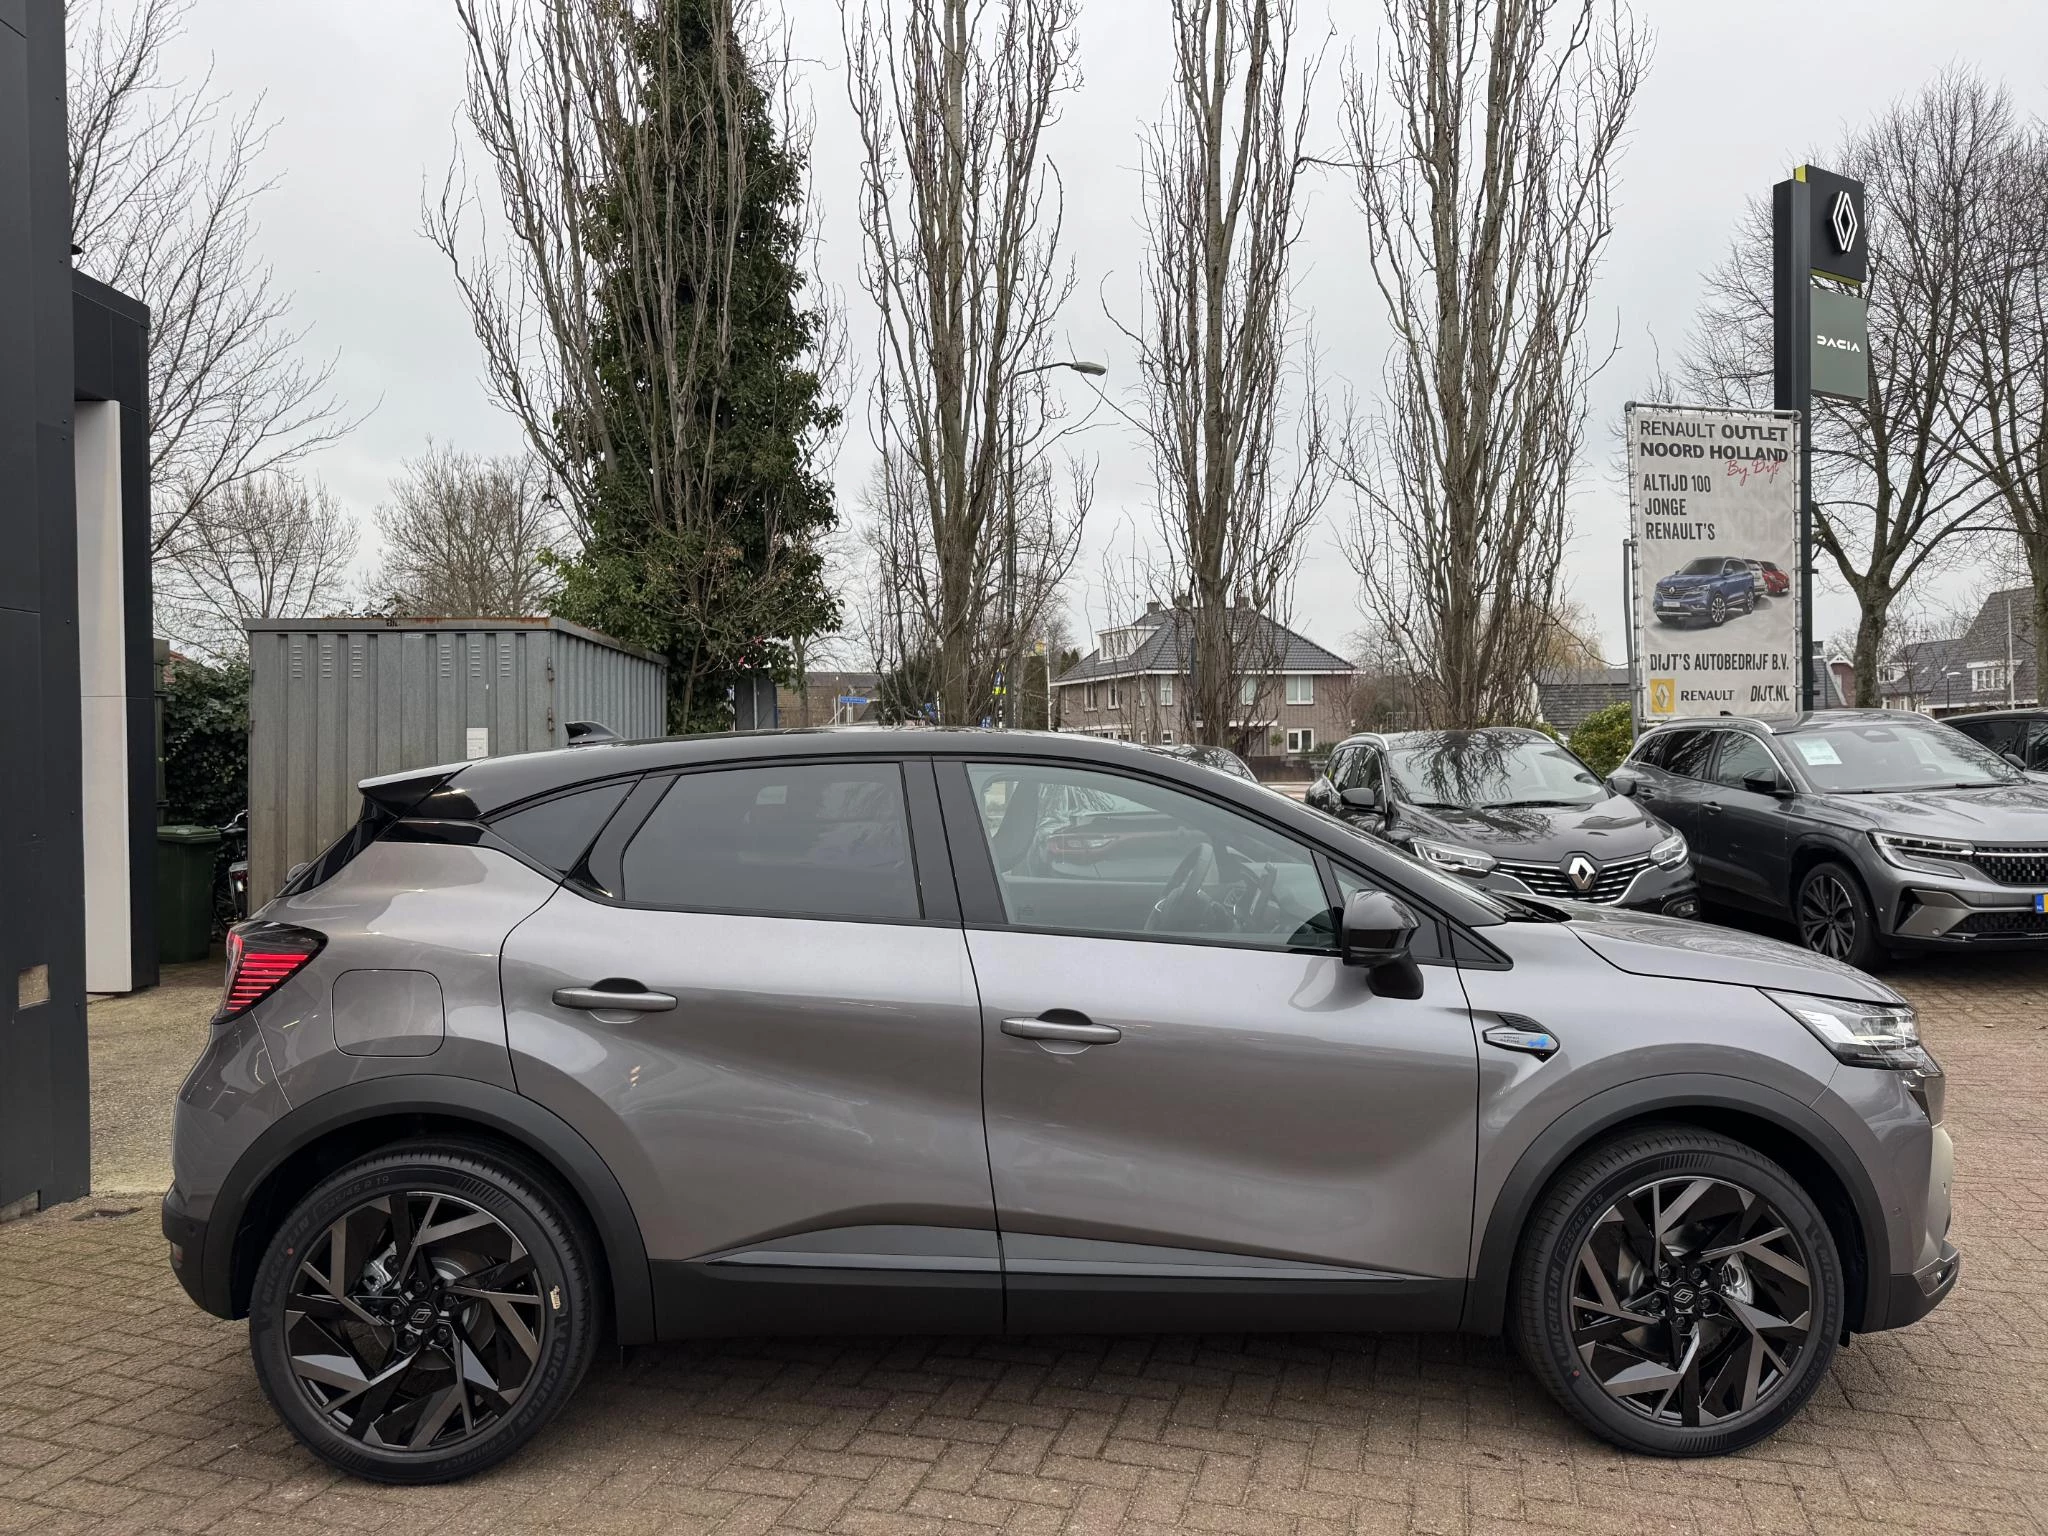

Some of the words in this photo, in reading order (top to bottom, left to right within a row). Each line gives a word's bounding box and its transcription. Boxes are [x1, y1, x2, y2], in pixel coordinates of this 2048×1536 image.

[1816, 334, 1861, 353] DACIA
[1640, 420, 1715, 439] RENAULT
[1721, 424, 1788, 442] OUTLET
[1640, 442, 1705, 459] NOORD
[1710, 445, 1788, 463] HOLLAND
[1643, 473, 1688, 491] ALTIJD
[1691, 474, 1711, 493] 100
[1644, 497, 1687, 516] JONGE
[1645, 522, 1715, 540] RENAULT'S
[1650, 653, 1690, 671] DIJT'S
[1694, 653, 1768, 671] AUTOBEDRIJF
[1772, 653, 1789, 671] B.V.
[1680, 689, 1735, 701] RENAULT
[1750, 685, 1790, 702] DIJT.NL
[1818, 1249, 1837, 1337] MICHELIN
[1547, 1266, 1568, 1356] MICHELIN
[517, 1342, 566, 1425] MICHELIN
